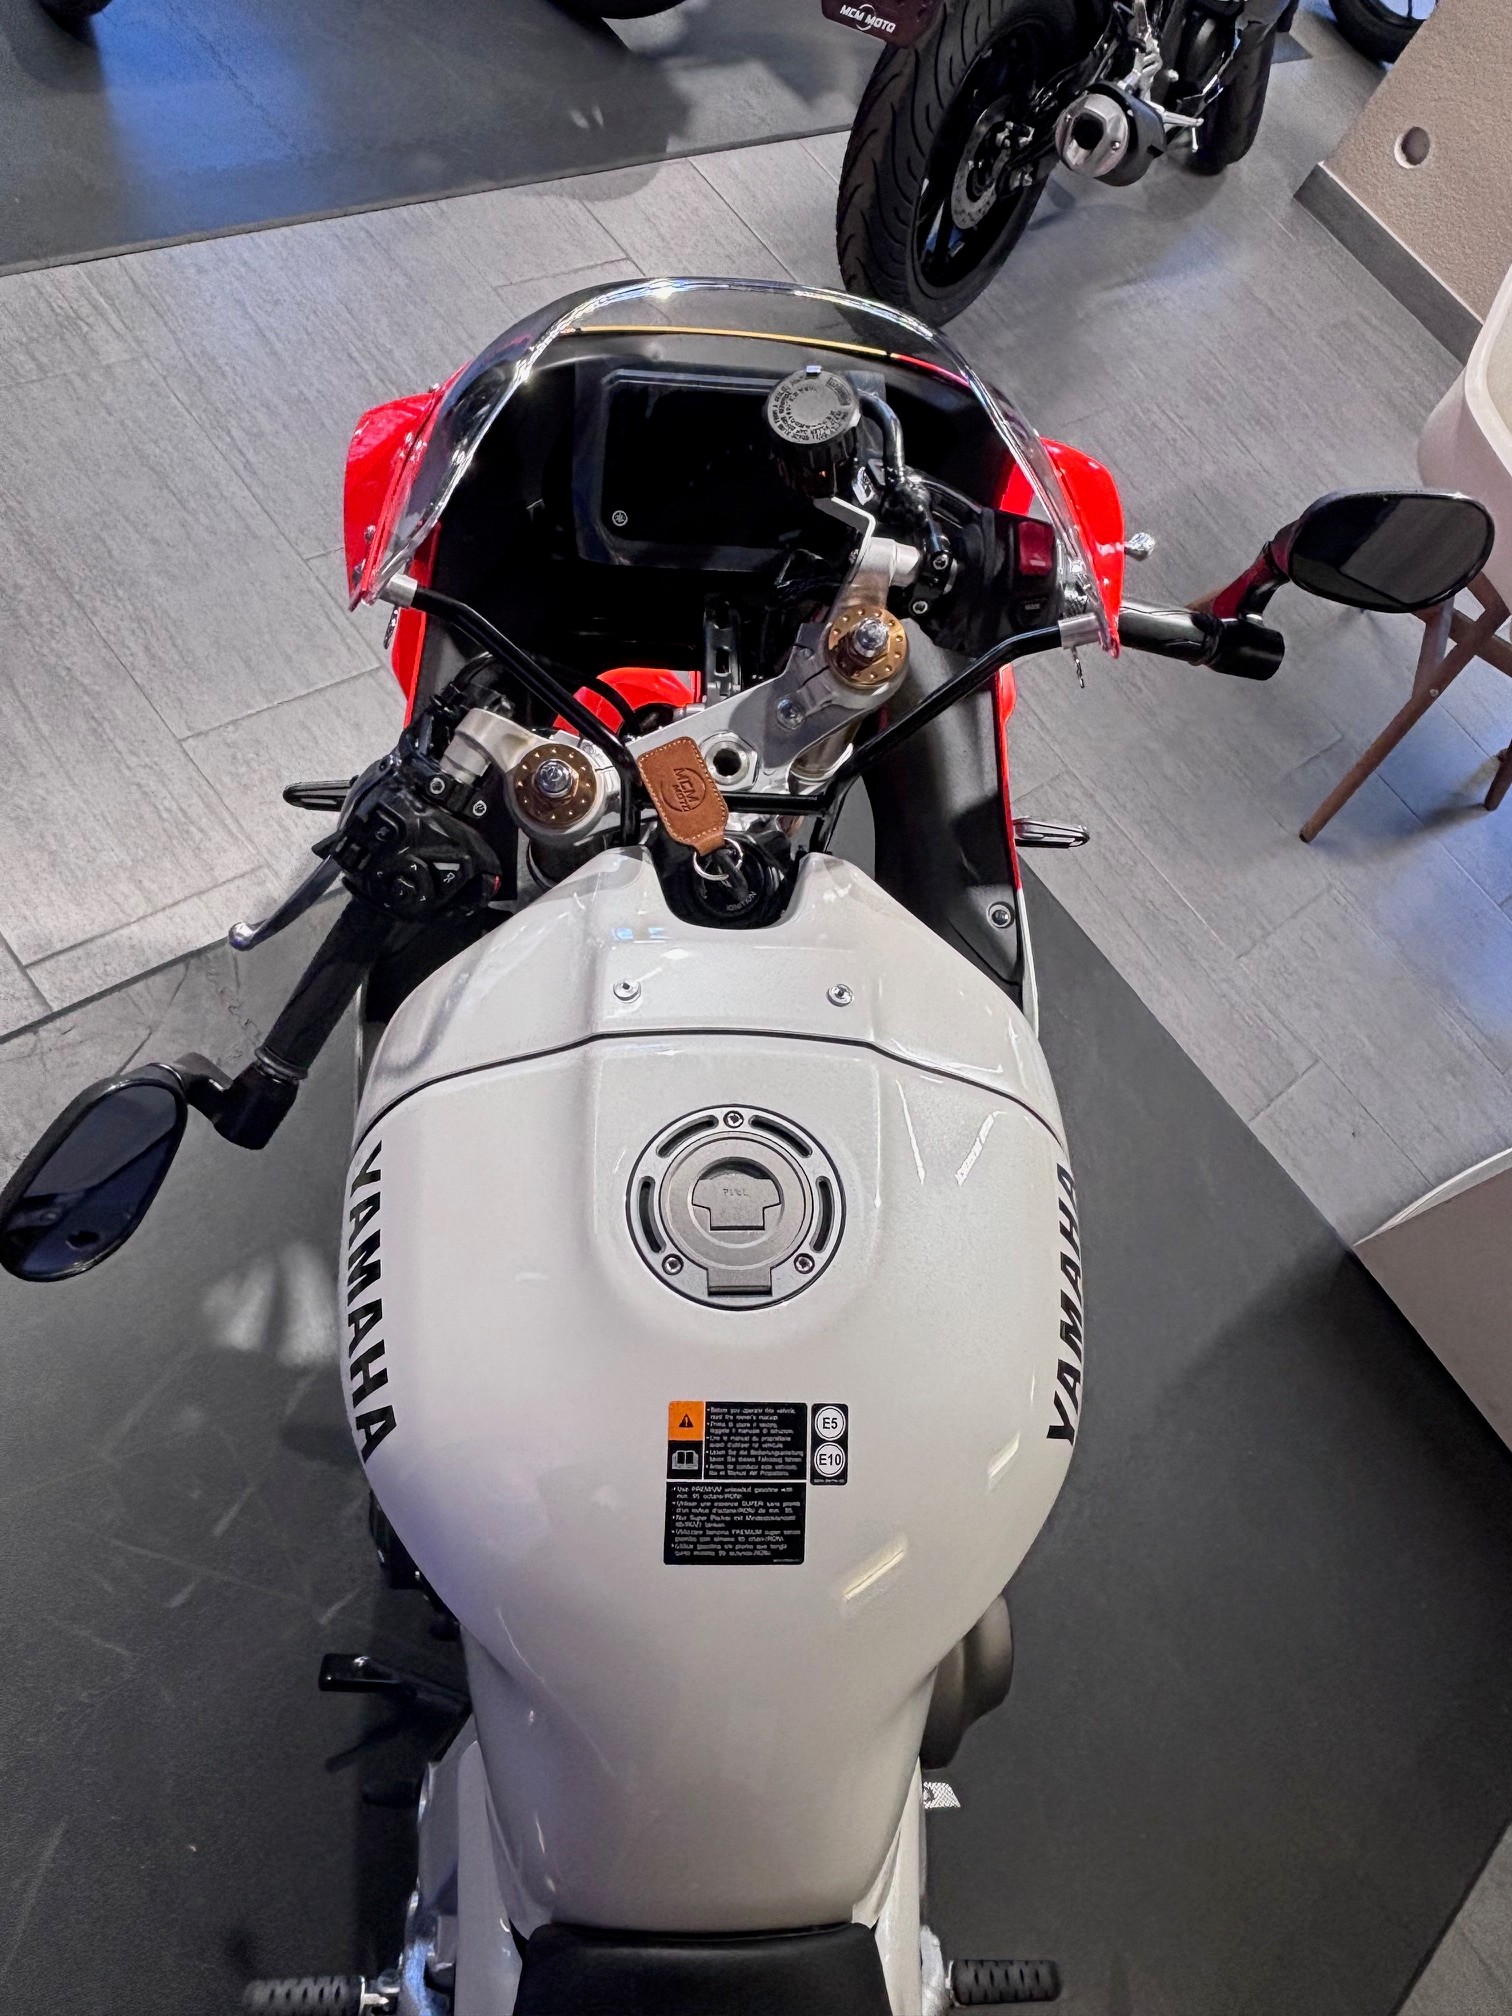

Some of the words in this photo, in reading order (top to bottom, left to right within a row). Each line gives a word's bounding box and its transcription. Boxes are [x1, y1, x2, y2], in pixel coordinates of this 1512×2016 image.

[839, 4, 865, 22] MCM
[864, 14, 897, 33] MOTO
[673, 767, 700, 802] MCM
[347, 1140, 397, 1464] YAMAHA
[1046, 1162, 1084, 1446] YAMAHA
[822, 1417, 838, 1430] E5
[818, 1453, 842, 1466] E10
